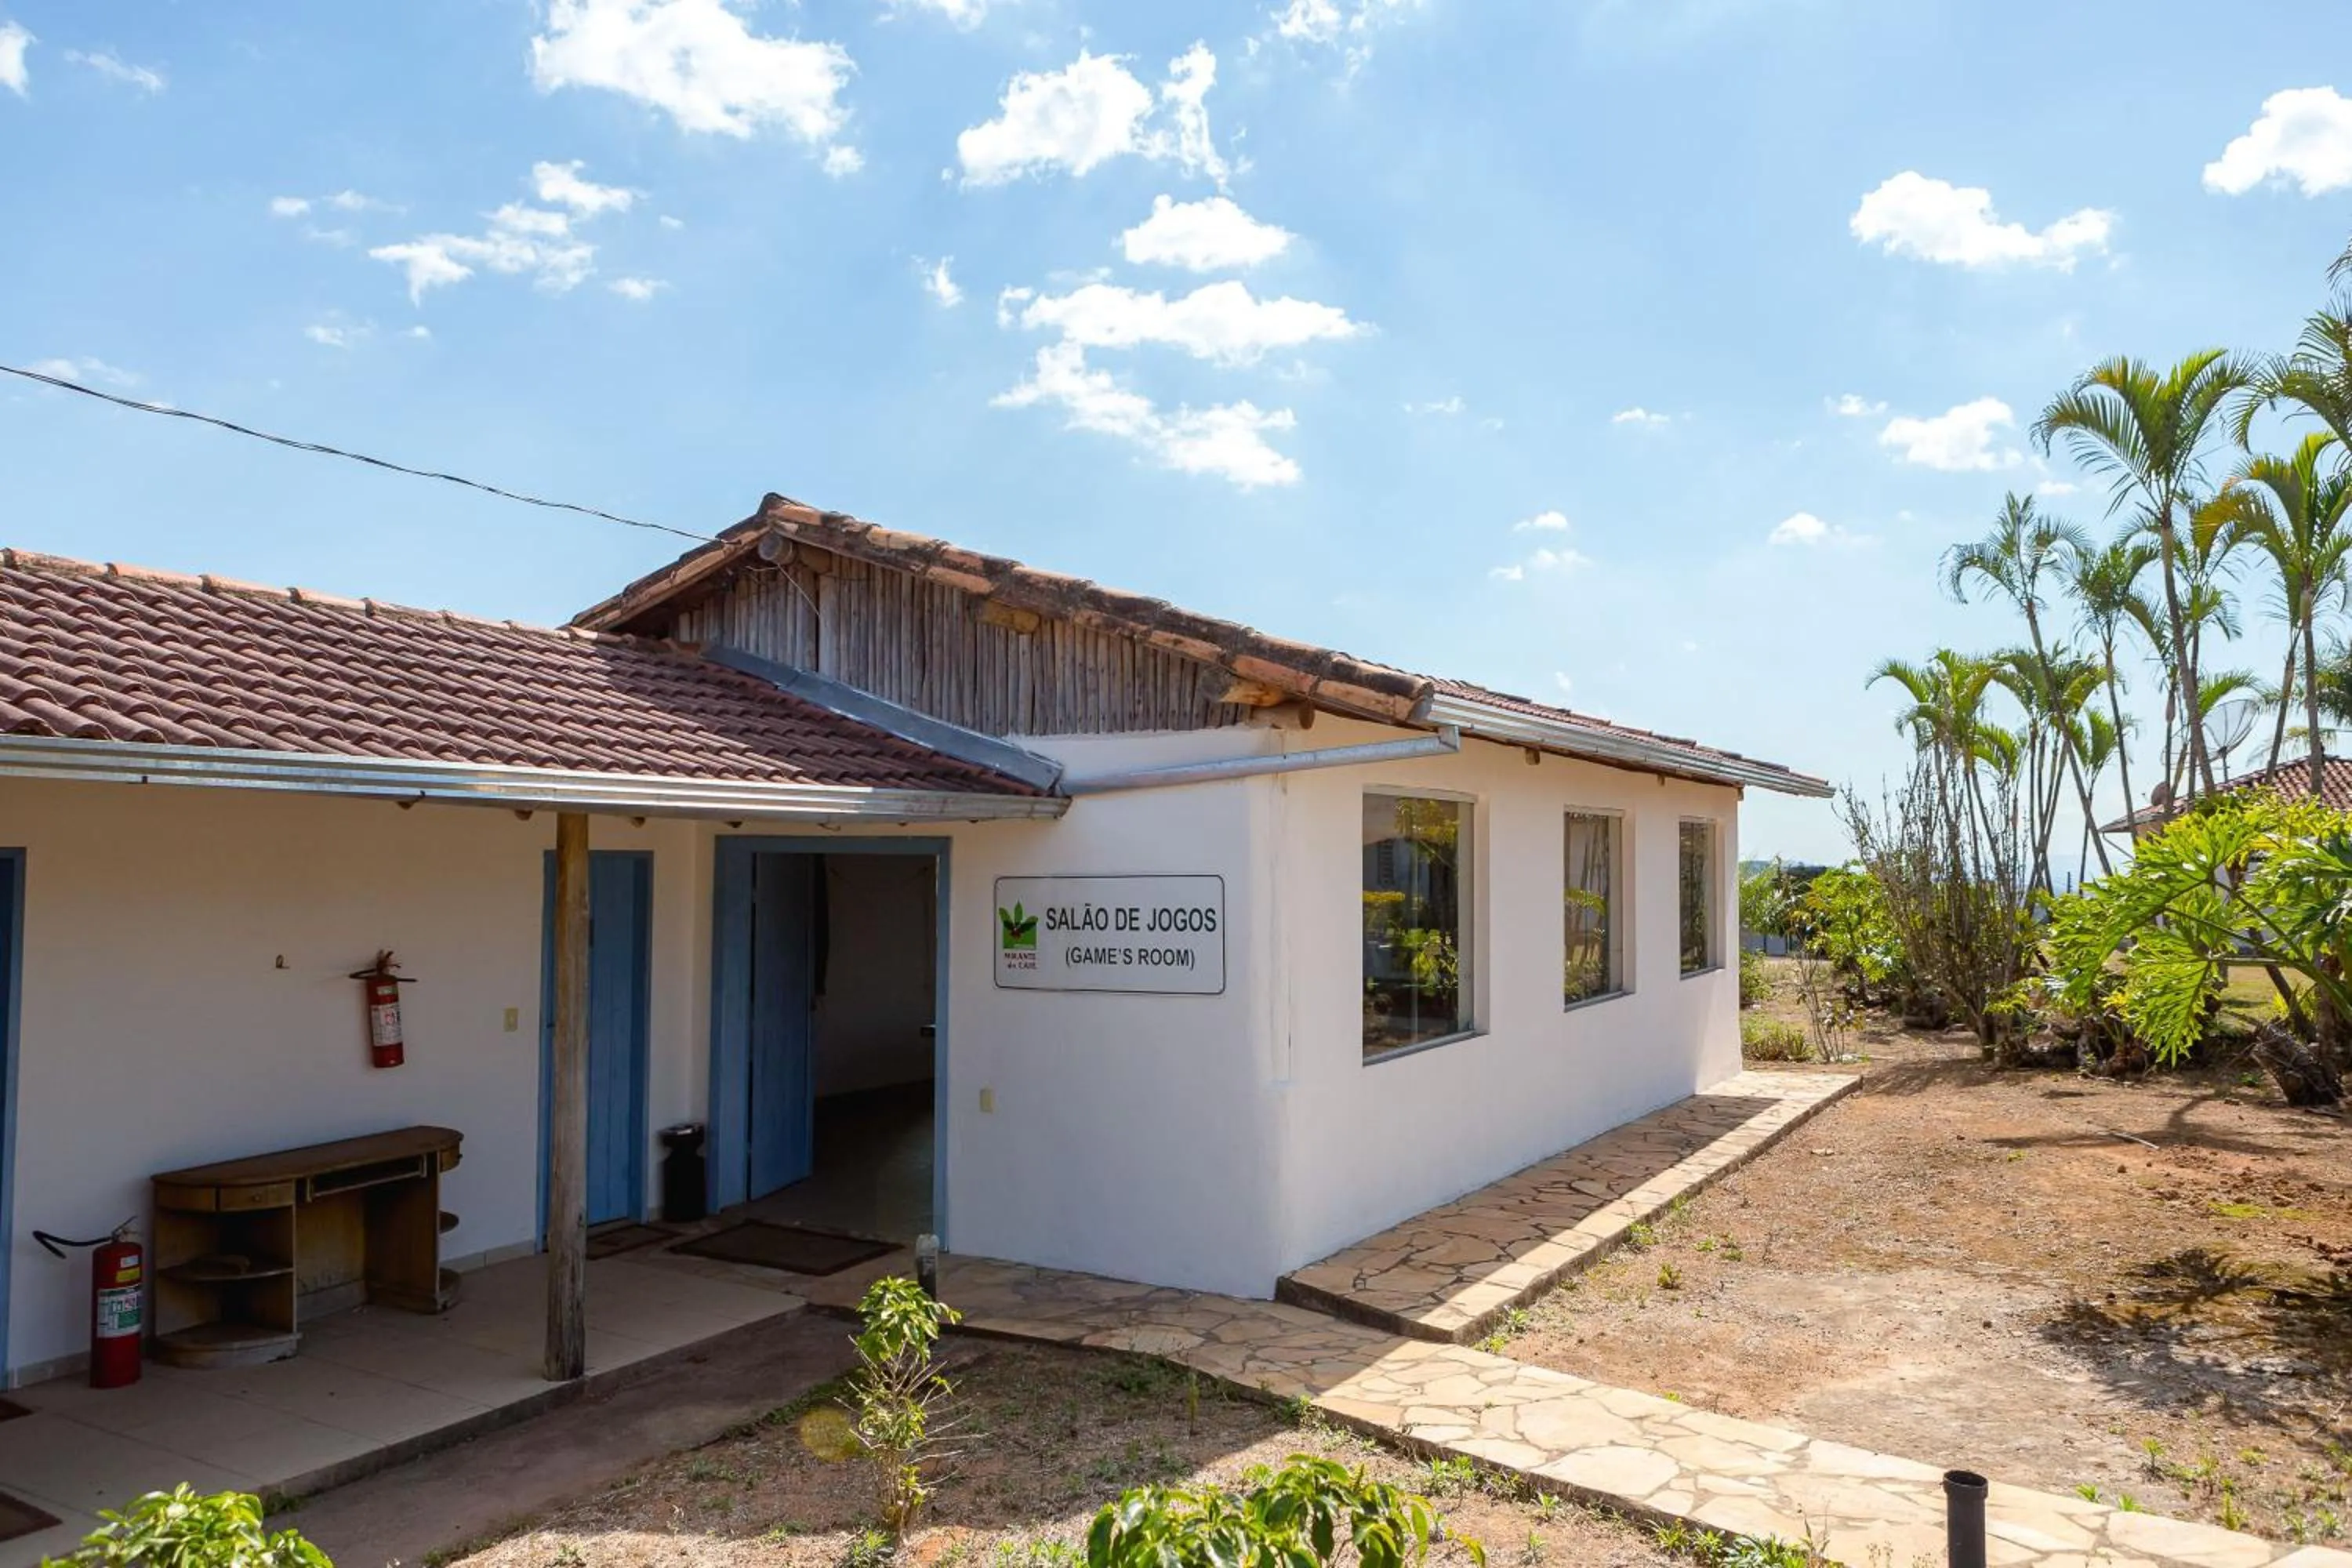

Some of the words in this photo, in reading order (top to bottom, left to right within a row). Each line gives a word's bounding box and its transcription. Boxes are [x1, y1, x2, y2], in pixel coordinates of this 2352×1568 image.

[1045, 903, 1108, 931] SALÃO
[1116, 907, 1140, 931] DE
[1147, 907, 1217, 932] JOGOS
[1065, 947, 1133, 967] (GAME'S
[1138, 948, 1195, 971] ROOM)
